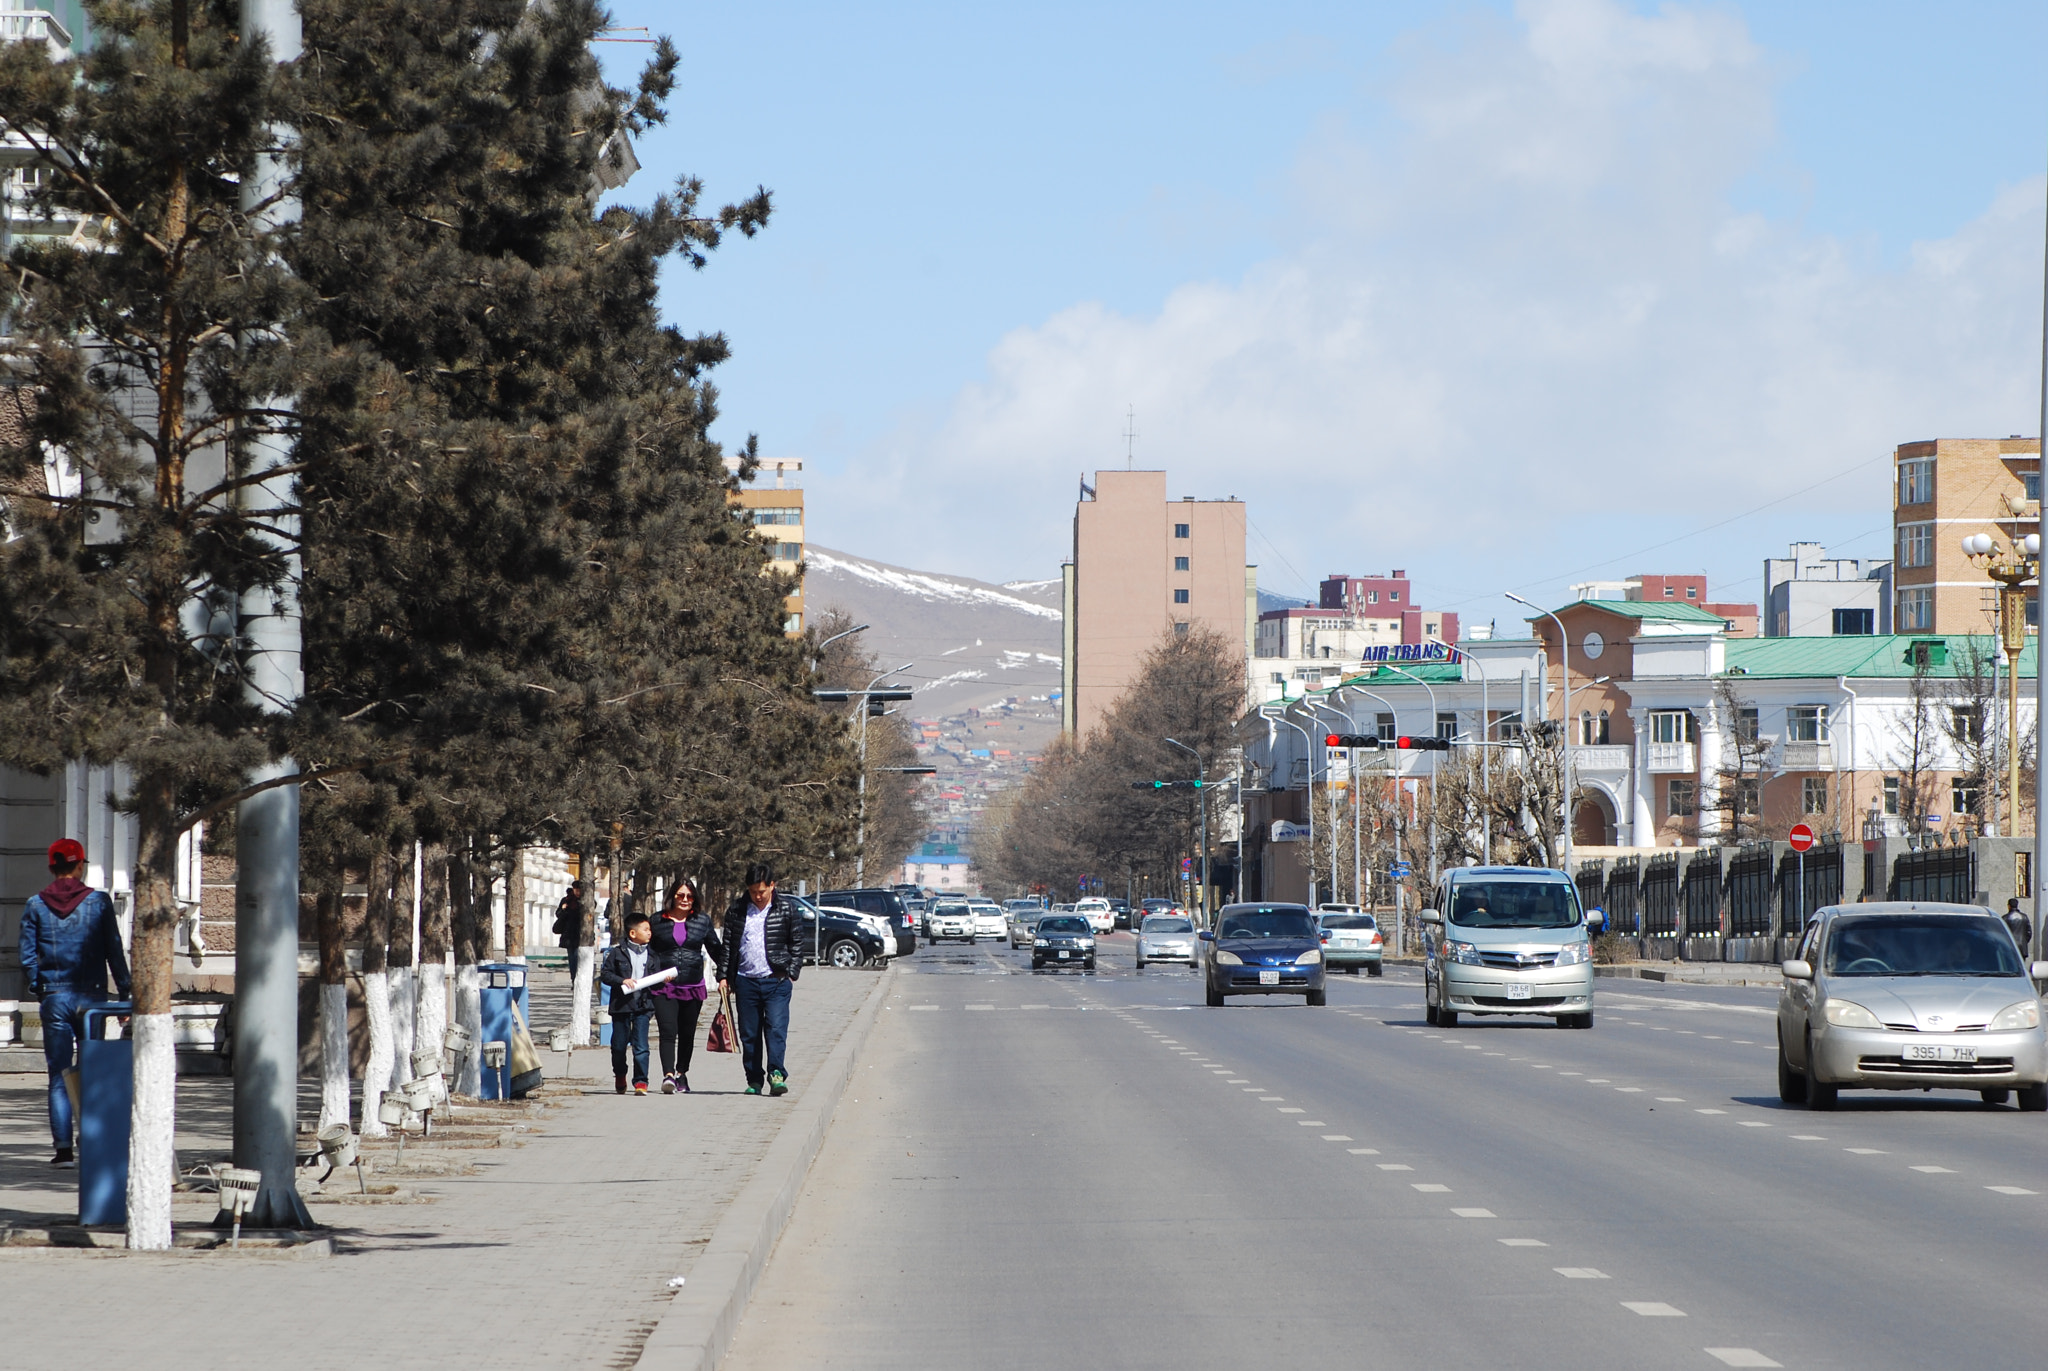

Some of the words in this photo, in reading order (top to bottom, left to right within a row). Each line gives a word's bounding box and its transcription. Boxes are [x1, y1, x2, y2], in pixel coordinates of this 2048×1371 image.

[1362, 645, 1390, 661] AIR
[1394, 643, 1444, 660] TRANS
[1912, 1046, 1942, 1059] 3951
